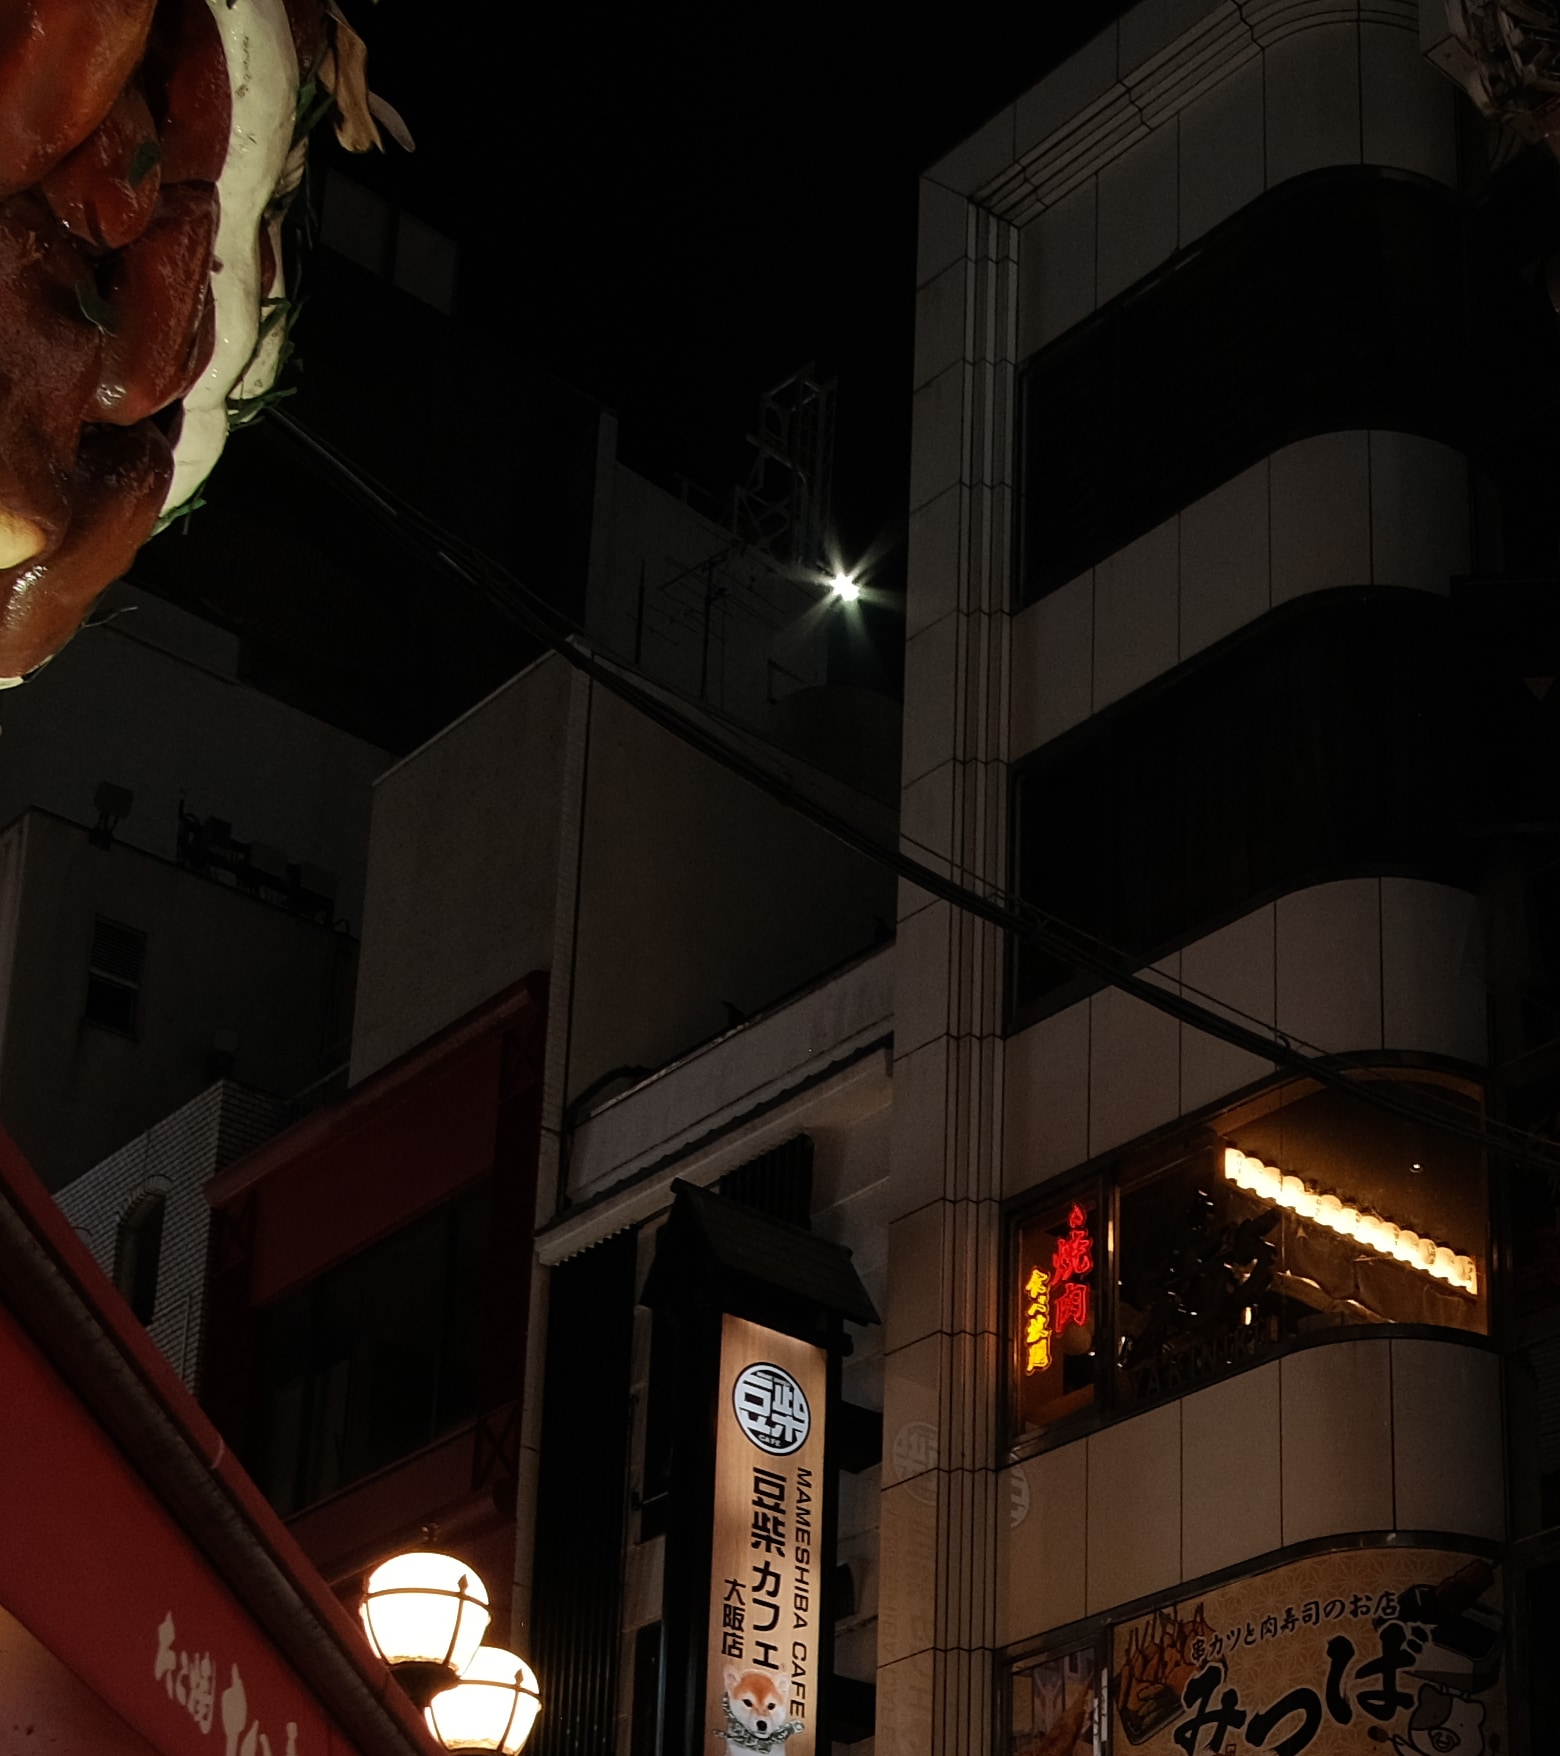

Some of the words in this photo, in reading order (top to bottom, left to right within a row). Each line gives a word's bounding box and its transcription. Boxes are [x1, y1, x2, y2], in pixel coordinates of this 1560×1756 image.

[1051, 1227, 1094, 1335] 焼肉
[736, 1370, 808, 1434] 豆柴
[757, 1433, 783, 1447] CAFE
[750, 1468, 788, 1672] 豆柴カフェ
[790, 1466, 814, 1632] MAMESHIBA
[721, 1578, 746, 1662] 大阪店
[1190, 1590, 1401, 1663] 串カツと肉寿司のお店
[790, 1638, 808, 1722] CAFE
